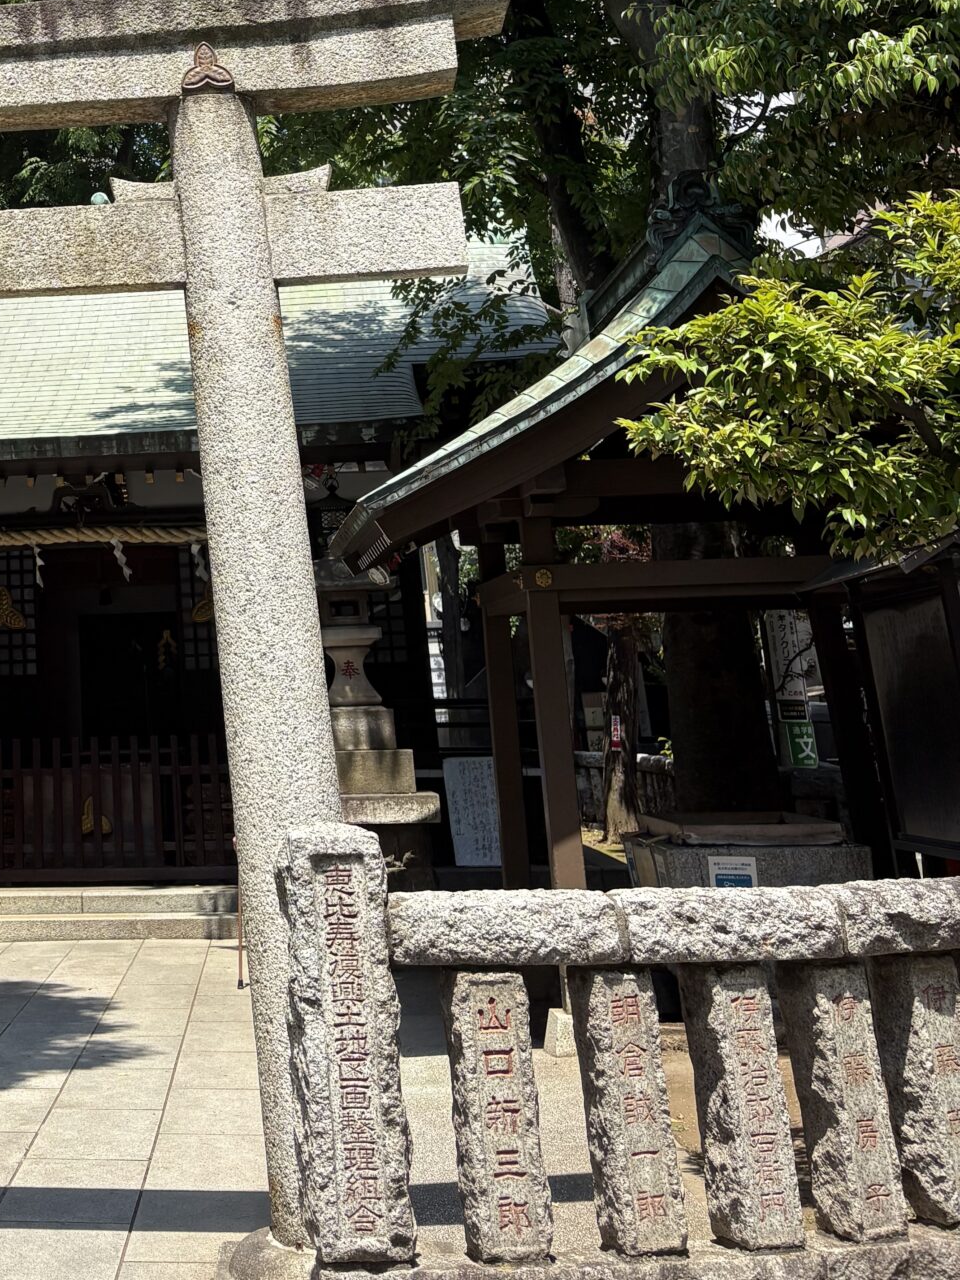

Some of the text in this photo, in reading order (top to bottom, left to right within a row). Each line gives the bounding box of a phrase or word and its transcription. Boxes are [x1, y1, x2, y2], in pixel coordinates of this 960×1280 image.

[341, 660, 360, 680] 奉
[795, 735, 816, 759] 文
[323, 864, 384, 1232] 恵比寿復興土地区画整理組合
[478, 996, 531, 1237] 山口新三郎
